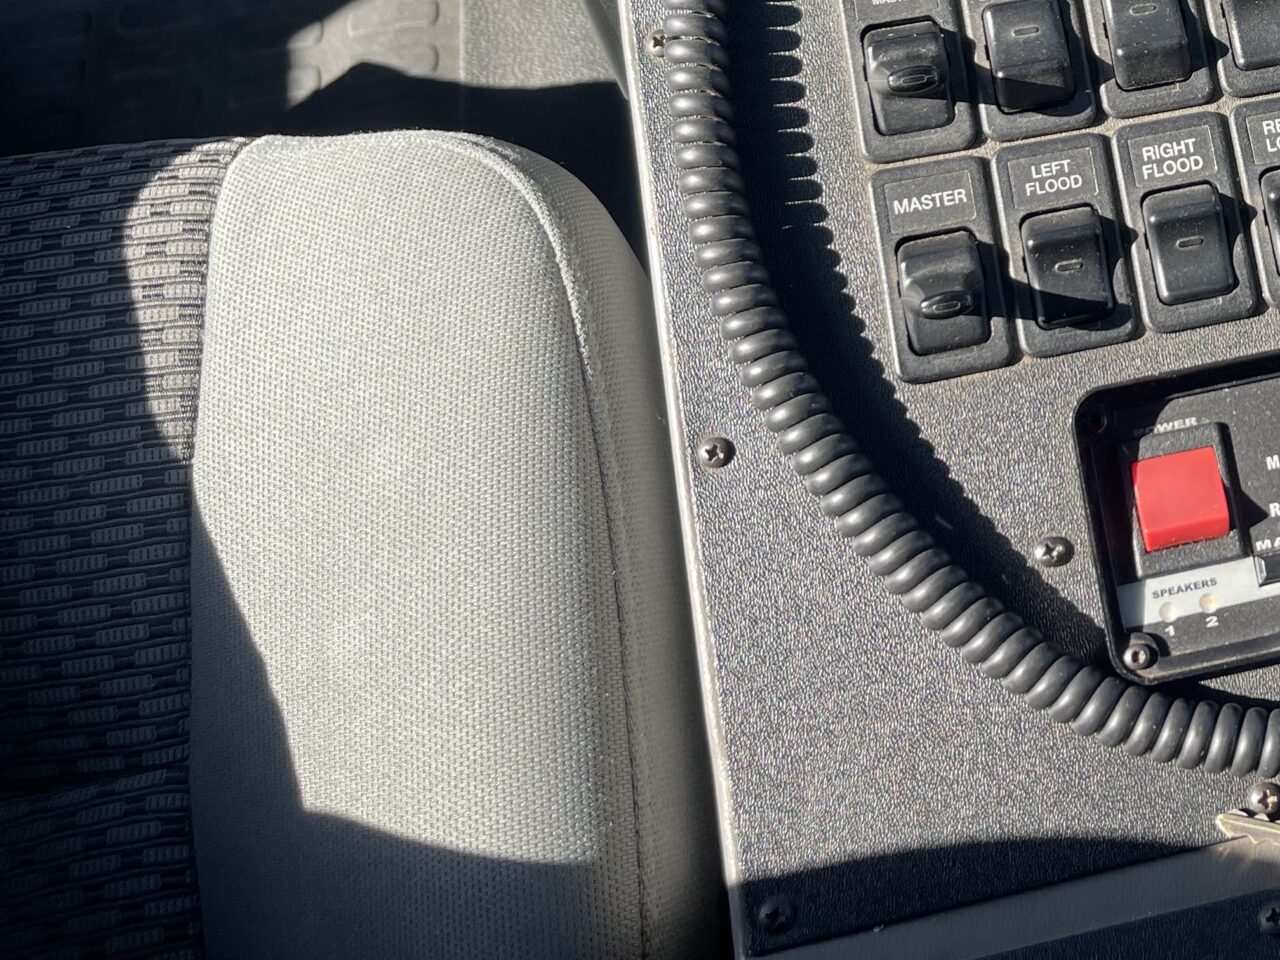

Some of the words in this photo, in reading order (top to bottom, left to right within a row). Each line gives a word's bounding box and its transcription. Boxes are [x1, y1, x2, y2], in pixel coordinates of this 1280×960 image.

[1141, 137, 1198, 162] RIGHT
[1030, 159, 1072, 181] LEFT
[1142, 153, 1204, 179] FLOOD
[1024, 172, 1084, 197] FLOOD
[892, 187, 968, 215] MASTER
[1152, 577, 1218, 600] SPEAKERS
[1165, 625, 1176, 638] 1
[1205, 614, 1220, 628] 2
